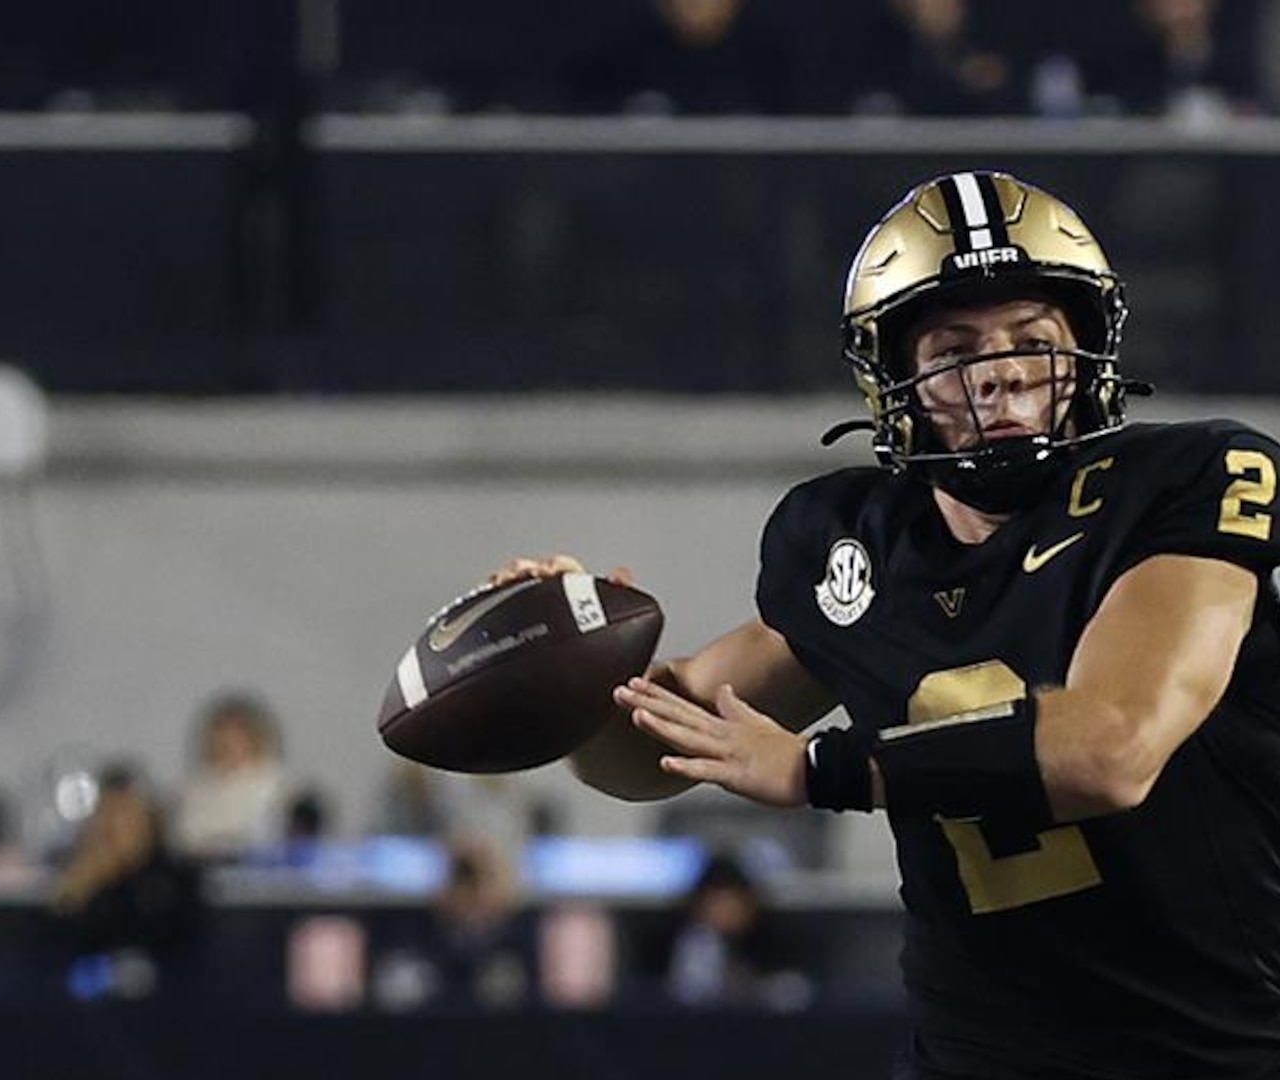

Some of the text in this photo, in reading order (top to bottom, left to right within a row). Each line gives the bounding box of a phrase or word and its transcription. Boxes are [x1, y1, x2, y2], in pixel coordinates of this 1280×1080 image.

[1067, 457, 1114, 518] C
[1217, 449, 1277, 541] 2
[934, 588, 965, 618] V
